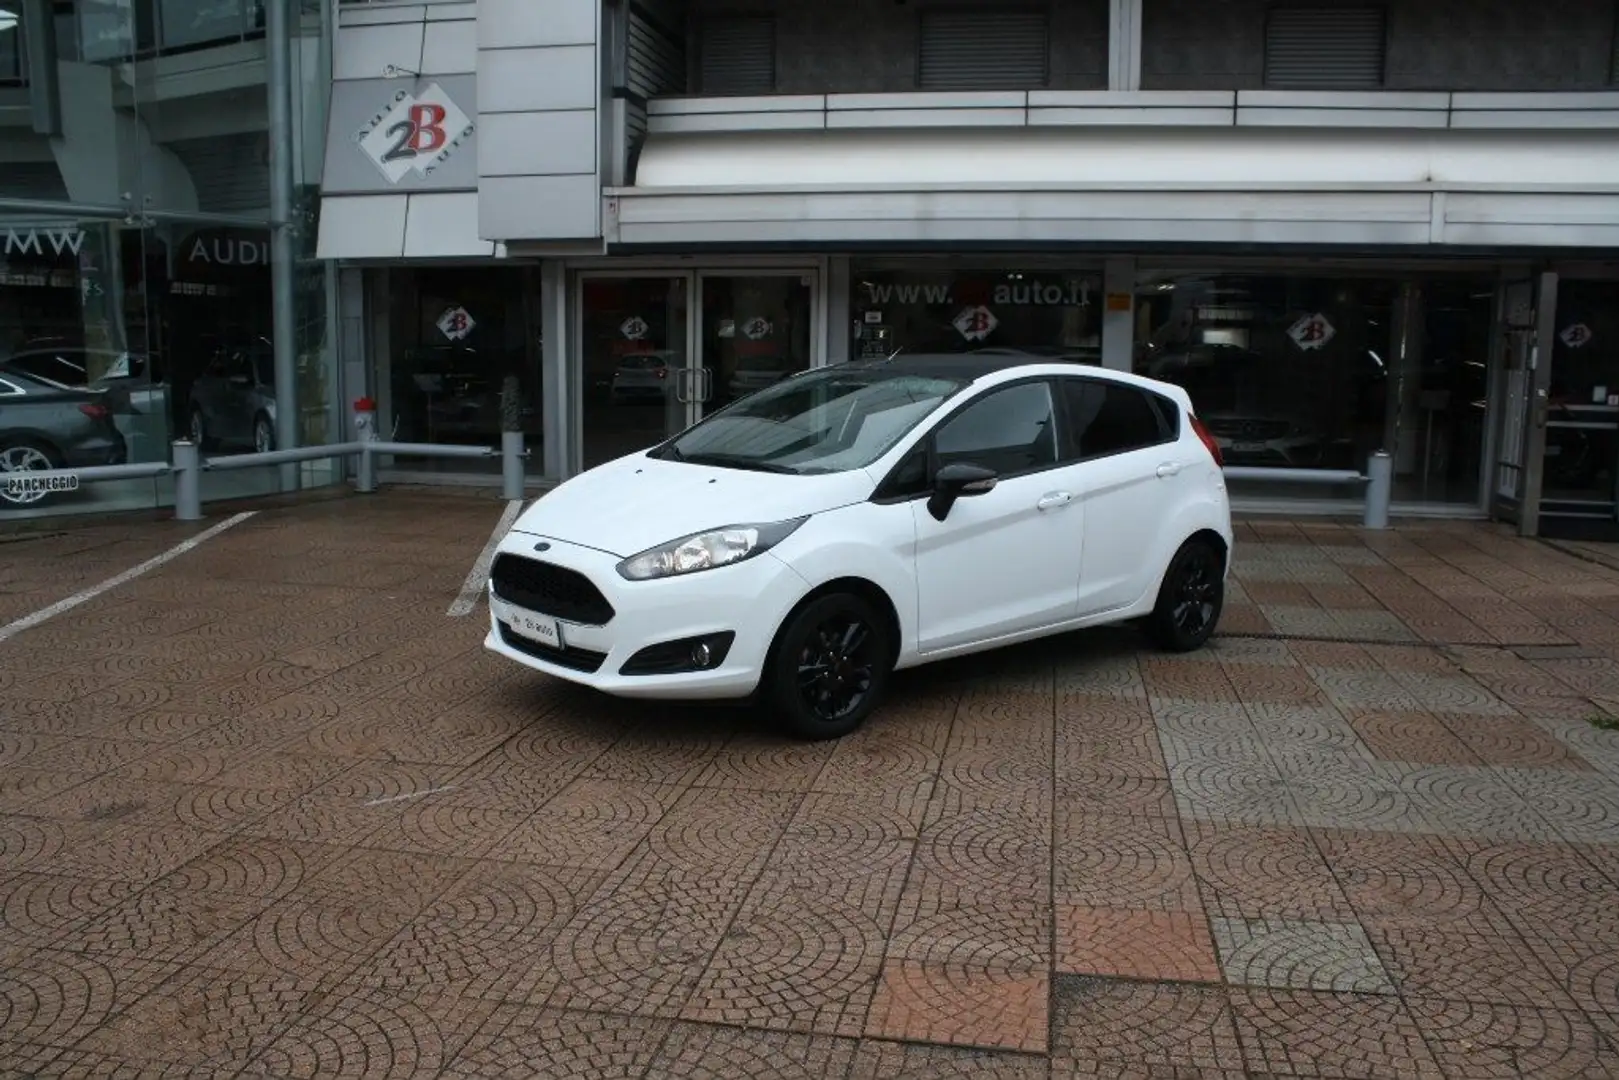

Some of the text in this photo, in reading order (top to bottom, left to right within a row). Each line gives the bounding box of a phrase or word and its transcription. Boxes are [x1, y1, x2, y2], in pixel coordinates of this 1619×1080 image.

[380, 104, 447, 164] 2B
[4, 228, 86, 256] MW
[188, 236, 268, 265] AUDI
[964, 311, 989, 333] 2B
[9, 475, 77, 492] PARCHEGGIO
